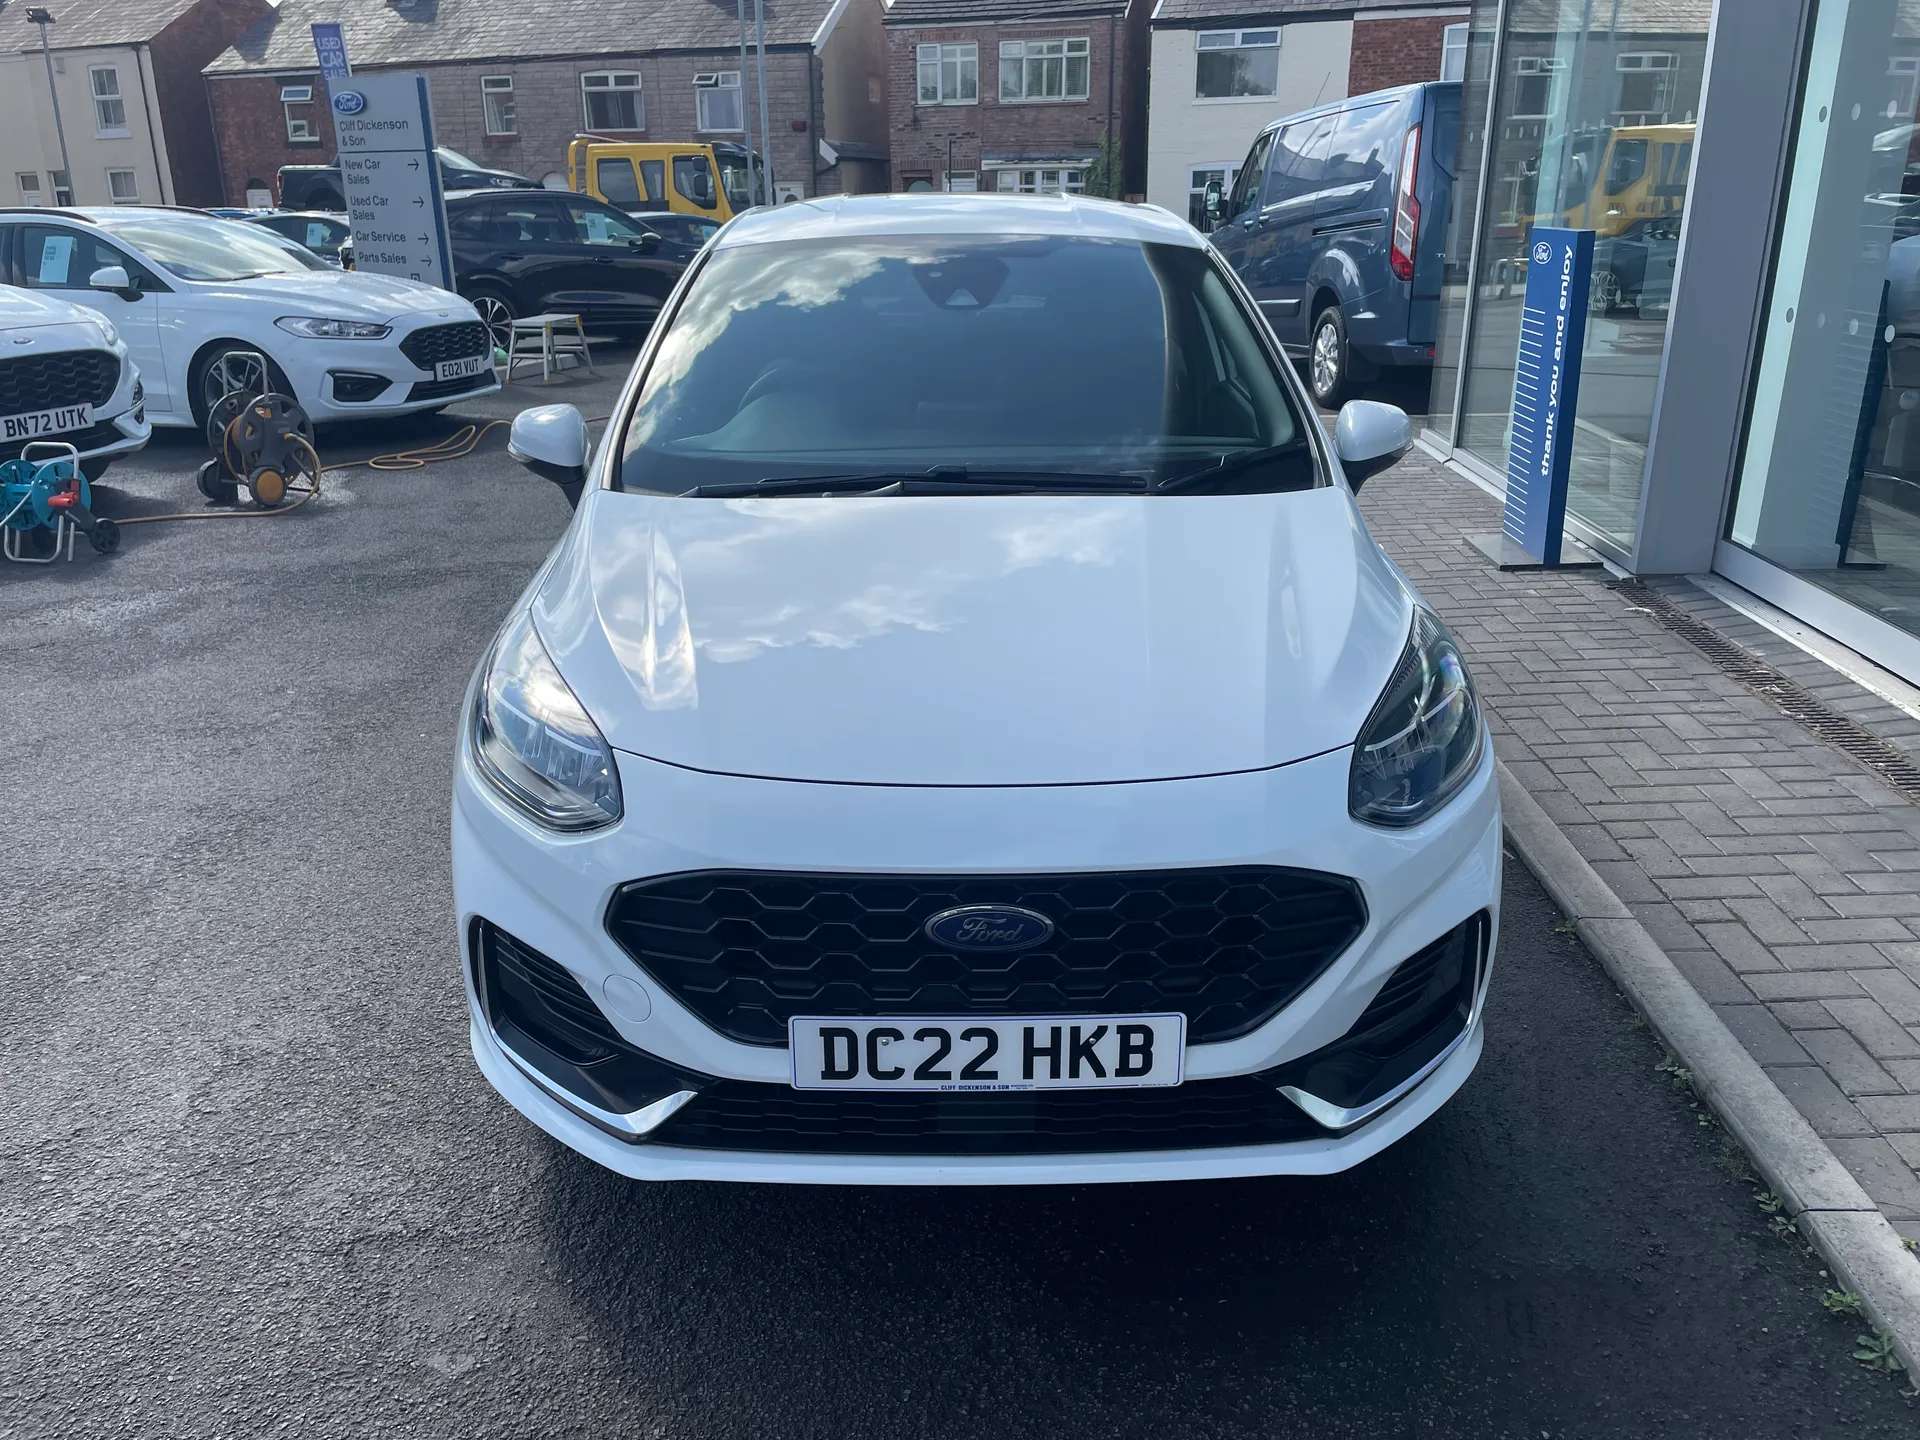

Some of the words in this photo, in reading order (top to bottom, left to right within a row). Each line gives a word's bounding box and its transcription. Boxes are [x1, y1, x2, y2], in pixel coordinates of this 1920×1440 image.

[316, 37, 341, 50] USED
[320, 51, 345, 67] CAR
[338, 94, 359, 110] Ford
[339, 121, 355, 132] Cliff
[357, 119, 409, 130] Dickenson
[342, 136, 349, 147] &
[350, 135, 366, 146] Son
[344, 160, 363, 170] New
[364, 159, 381, 169] Car
[347, 174, 370, 185] Sales
[350, 196, 371, 207] Used
[372, 196, 389, 206] Car
[352, 210, 376, 221] Sales
[355, 231, 370, 242] Car
[371, 231, 407, 242] Service
[358, 252, 379, 263] Parts
[380, 253, 407, 265] Sales
[1541, 411, 1555, 476] thank
[1549, 365, 1559, 407] you
[1554, 315, 1565, 361] and
[1560, 245, 1573, 311] enjoy
[4, 414, 52, 438] BN72
[55, 407, 88, 429] UTK
[956, 917, 1024, 940] Ford
[819, 1027, 999, 1081] DC22
[1022, 1024, 1154, 1080] HKB
